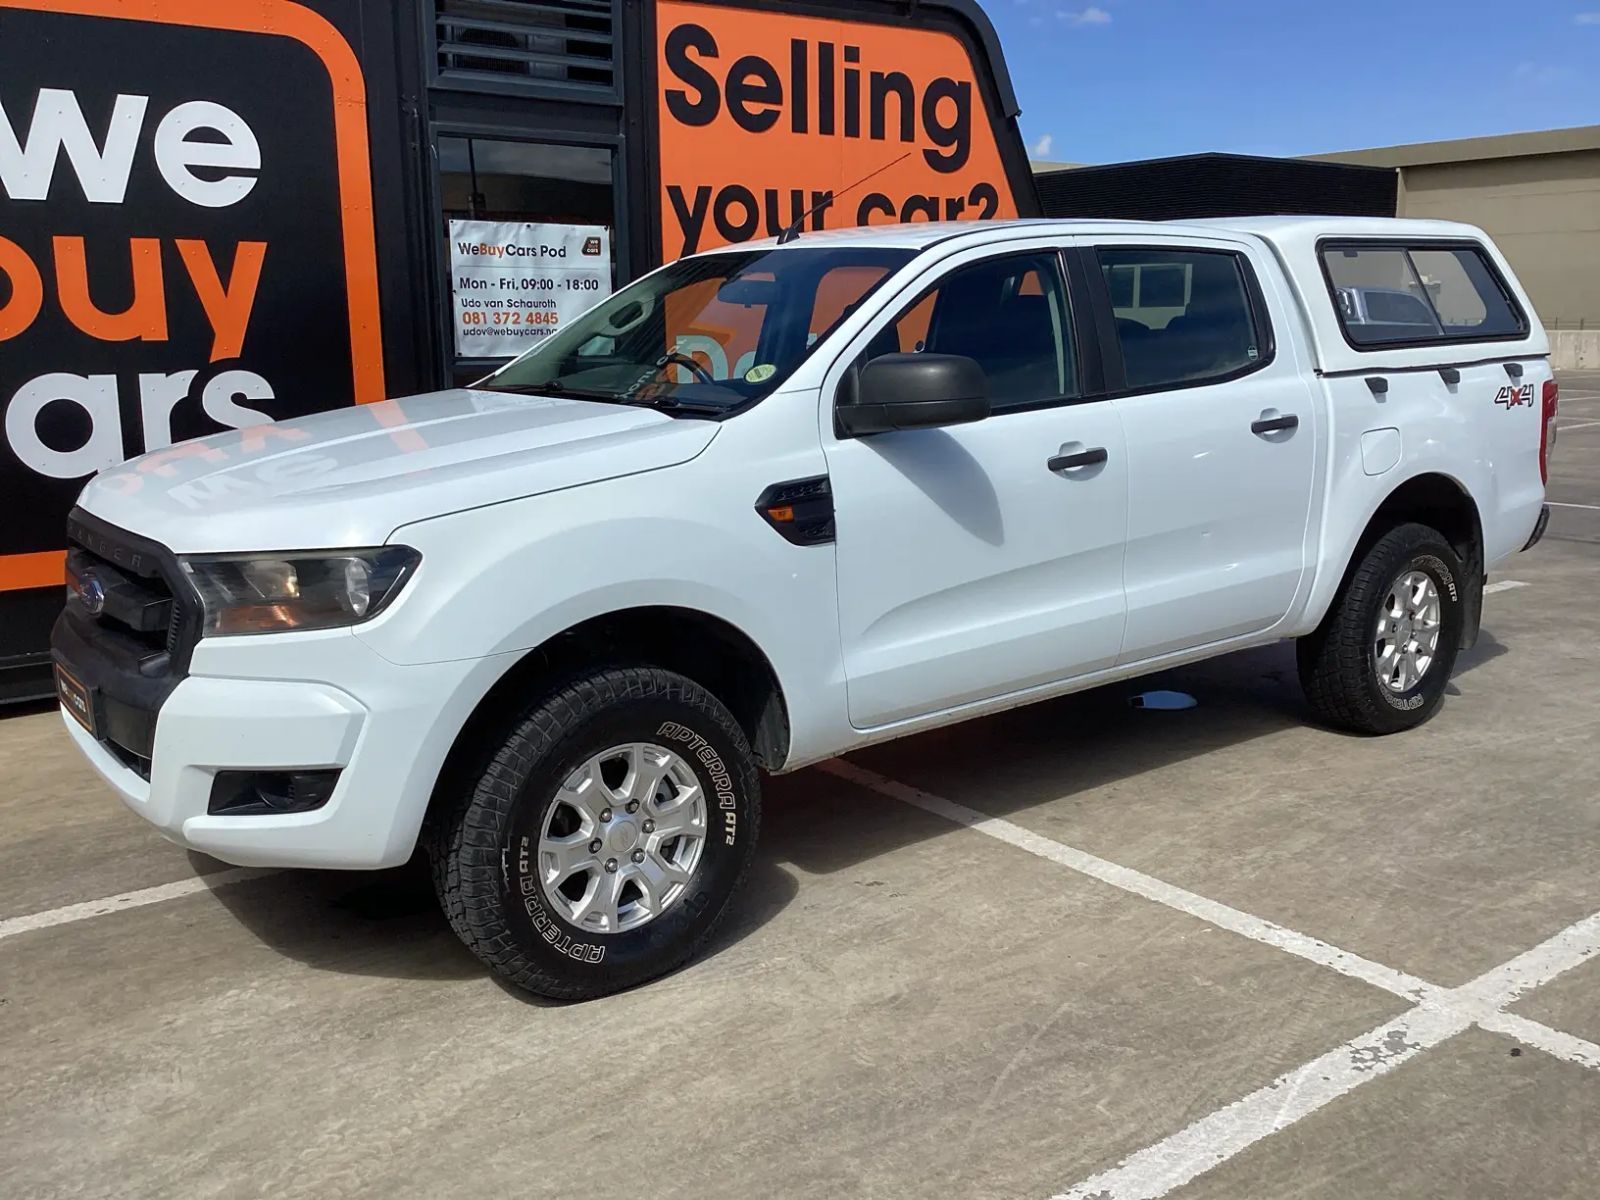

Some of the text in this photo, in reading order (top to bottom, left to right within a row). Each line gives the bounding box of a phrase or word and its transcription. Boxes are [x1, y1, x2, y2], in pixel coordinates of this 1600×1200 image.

[665, 23, 972, 173] Selling
[0, 87, 262, 208] we
[458, 242, 567, 258] WeBuyCars Pod
[666, 184, 834, 260] your
[459, 278, 487, 290] Mon
[500, 278, 519, 291] Fri,
[521, 279, 554, 290] 09:00
[566, 279, 599, 290] 18:00
[461, 298, 557, 308] Udo van Schauroth
[462, 312, 559, 325] 081 372 4845
[68, 524, 142, 568] ANGER
[655, 721, 737, 809] APTERRA
[519, 875, 606, 964] APTERRA
